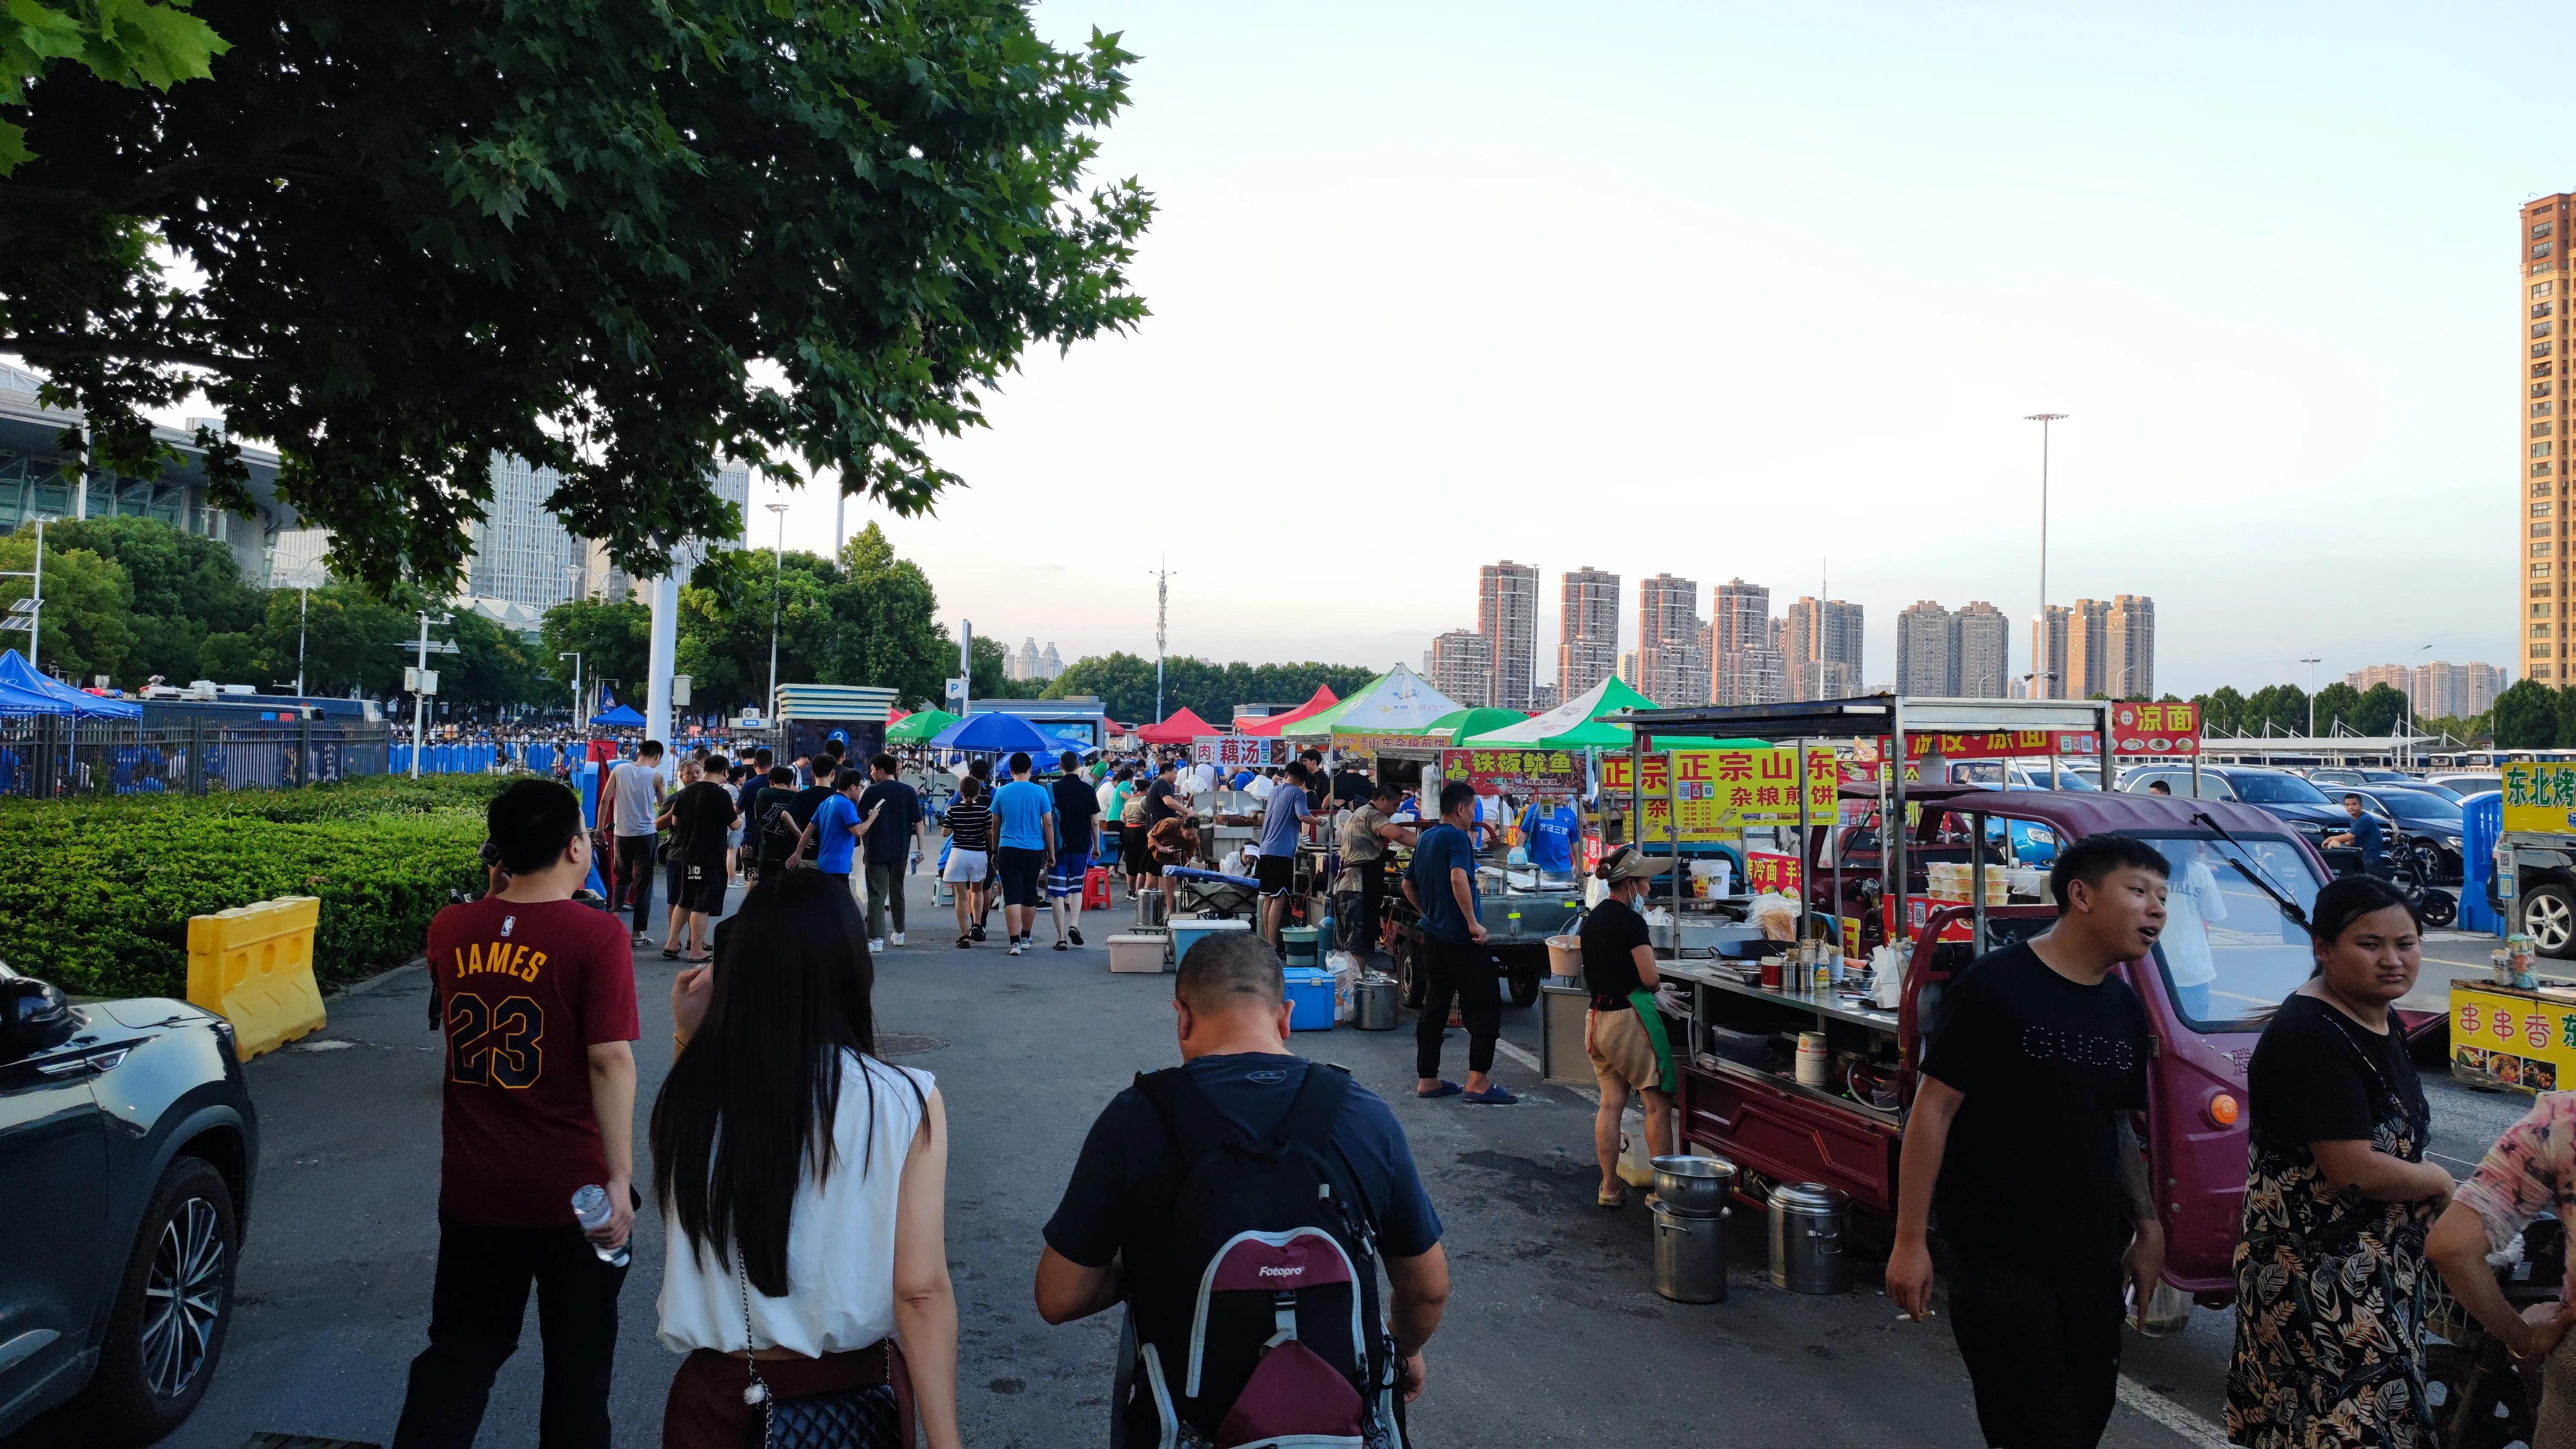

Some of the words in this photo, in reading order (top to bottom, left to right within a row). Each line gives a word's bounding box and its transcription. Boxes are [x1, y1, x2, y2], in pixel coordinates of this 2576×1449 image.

[951, 683, 959, 693] P
[2136, 705, 2192, 731] 凉面
[834, 731, 843, 742] 3
[1219, 739, 1259, 765] 藕汤
[1471, 751, 1572, 773] 铁板鱿鱼
[1603, 756, 1667, 790] 正宗
[1677, 750, 1836, 782] 正宗山东
[1729, 784, 1835, 807] 杂粮煎饼
[2507, 766, 2576, 808] 东北烤
[456, 942, 547, 982] JAMES
[2460, 1002, 2552, 1049] 串串香
[448, 992, 544, 1089] 23
[1258, 1266, 1302, 1278] Fotopro
